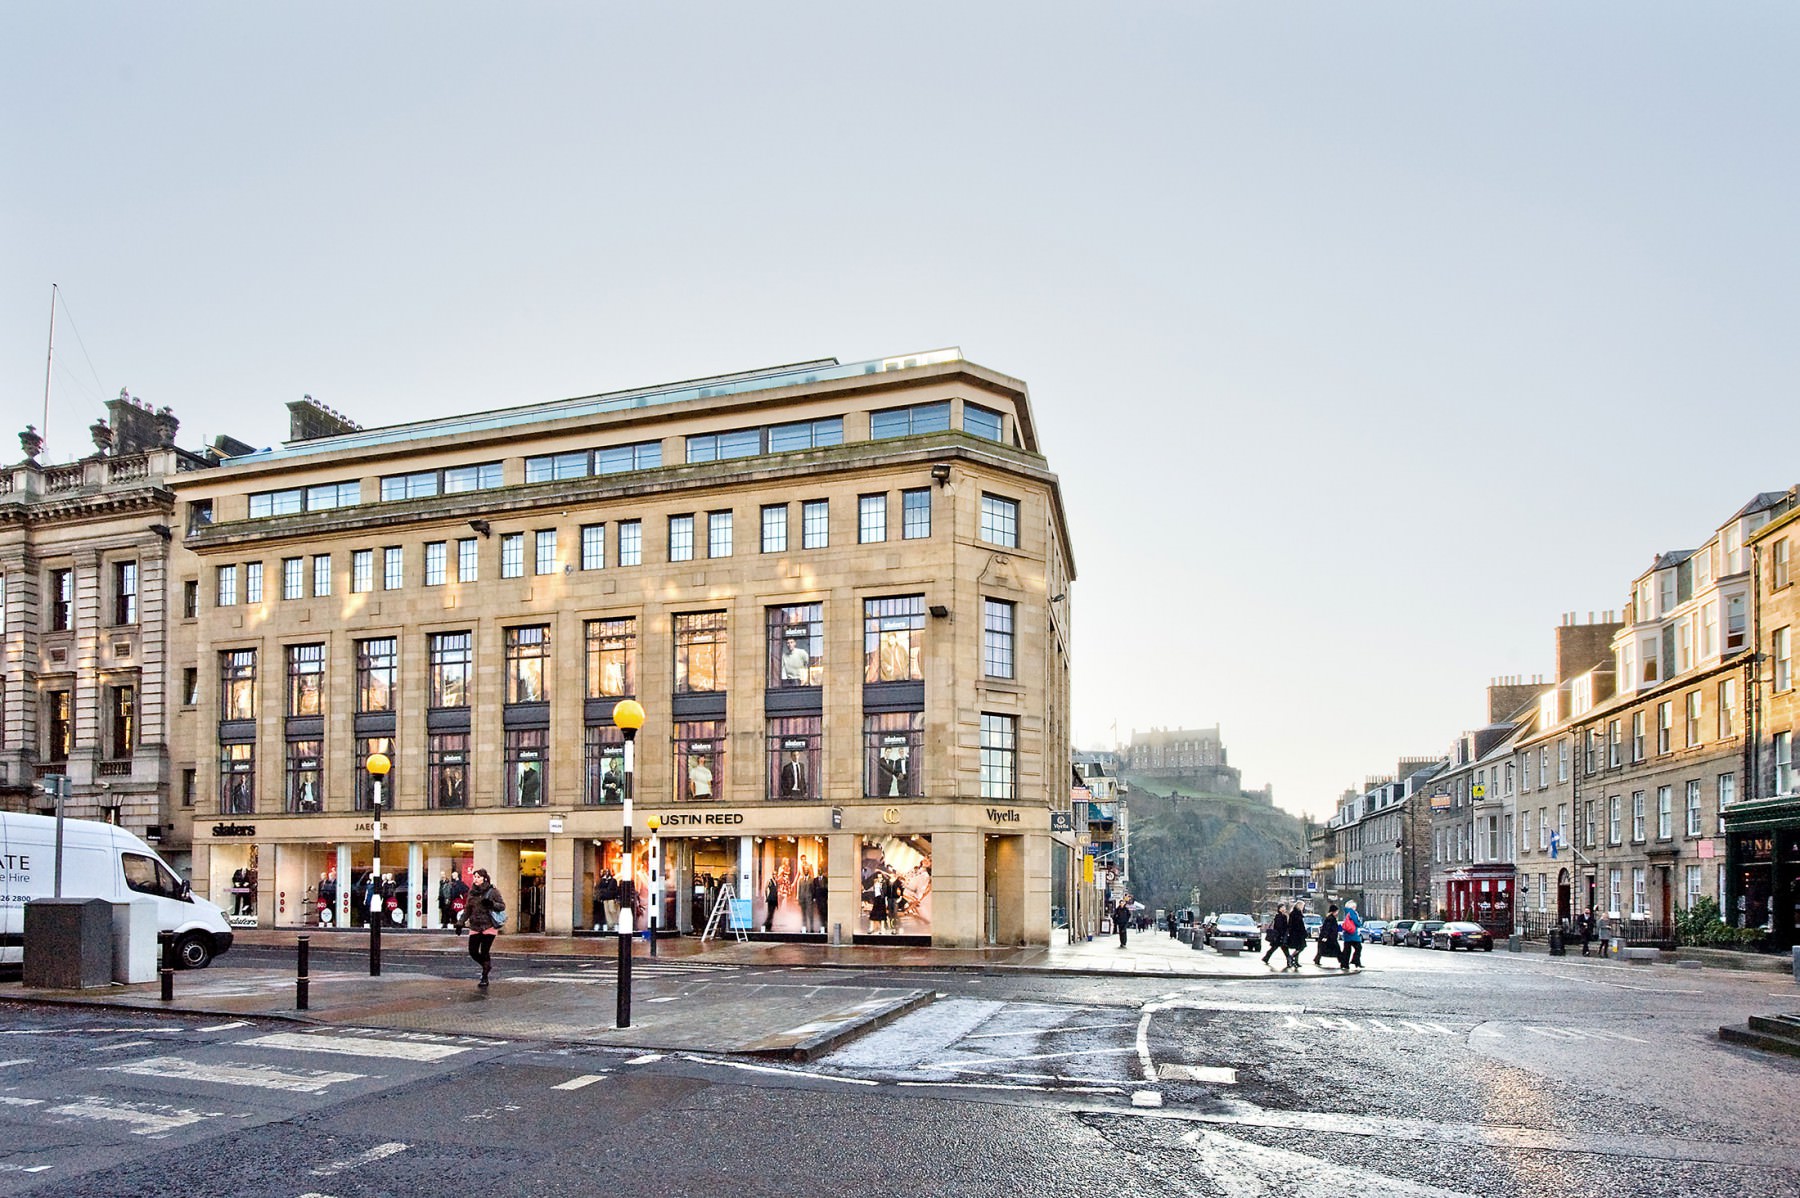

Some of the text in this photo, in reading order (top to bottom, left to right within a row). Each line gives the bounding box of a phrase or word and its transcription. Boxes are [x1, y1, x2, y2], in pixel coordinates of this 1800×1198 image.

[660, 814, 743, 825] USTIN REED
[986, 808, 1020, 824] Viyella
[212, 822, 256, 837] slaters
[9, 873, 30, 882] Hire
